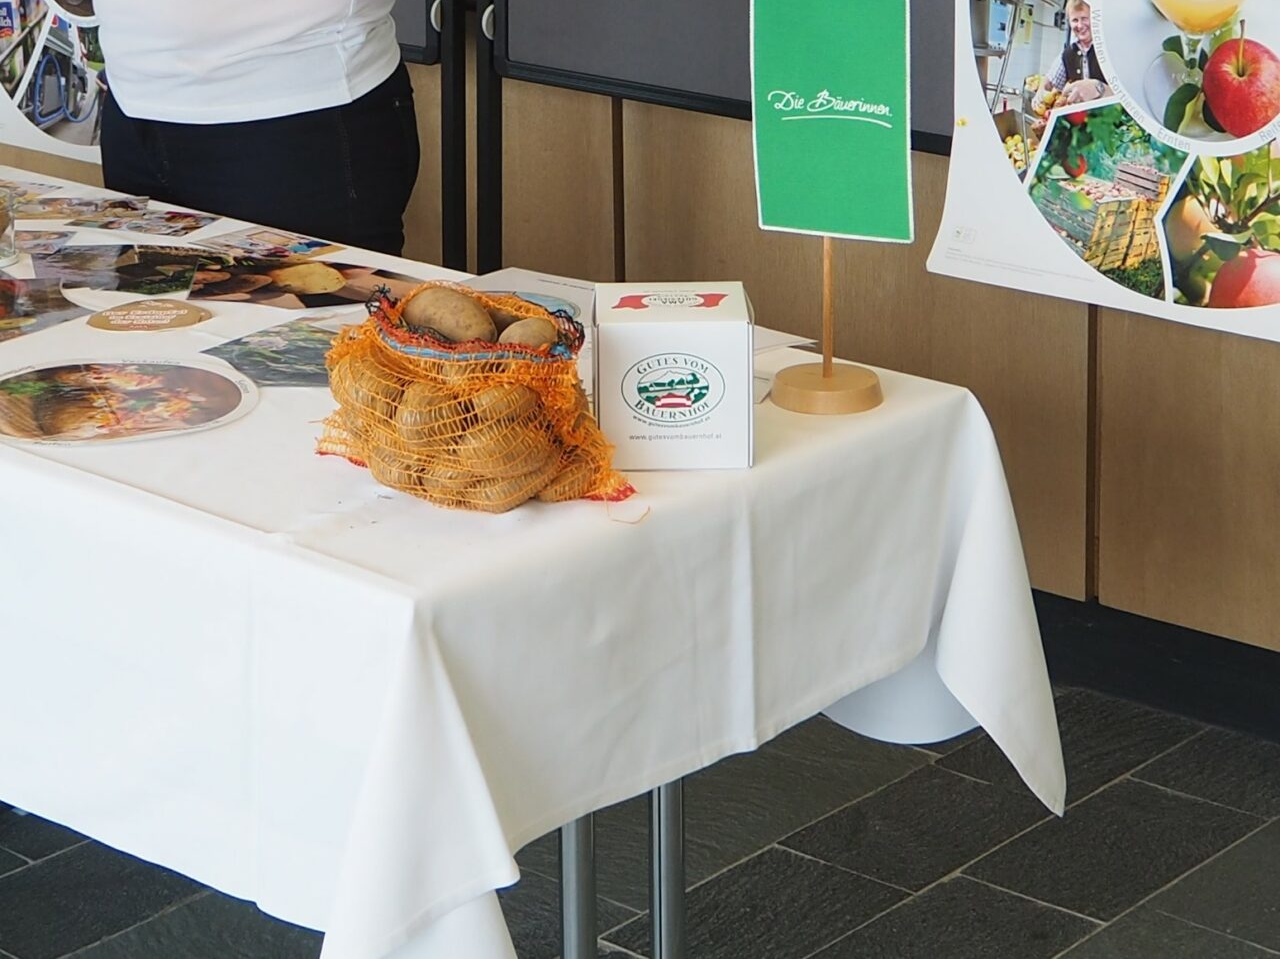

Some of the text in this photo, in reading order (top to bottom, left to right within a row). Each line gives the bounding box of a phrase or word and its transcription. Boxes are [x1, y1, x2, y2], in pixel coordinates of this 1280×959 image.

[1092, 9, 1106, 64] Waschen
[768, 88, 893, 117] Die Bäuerinnen.
[1108, 75, 1146, 123] Sortieren
[1156, 124, 1191, 151] Ernten
[636, 356, 710, 375] GUTES VOM
[634, 399, 711, 421] BAUERNHOF
